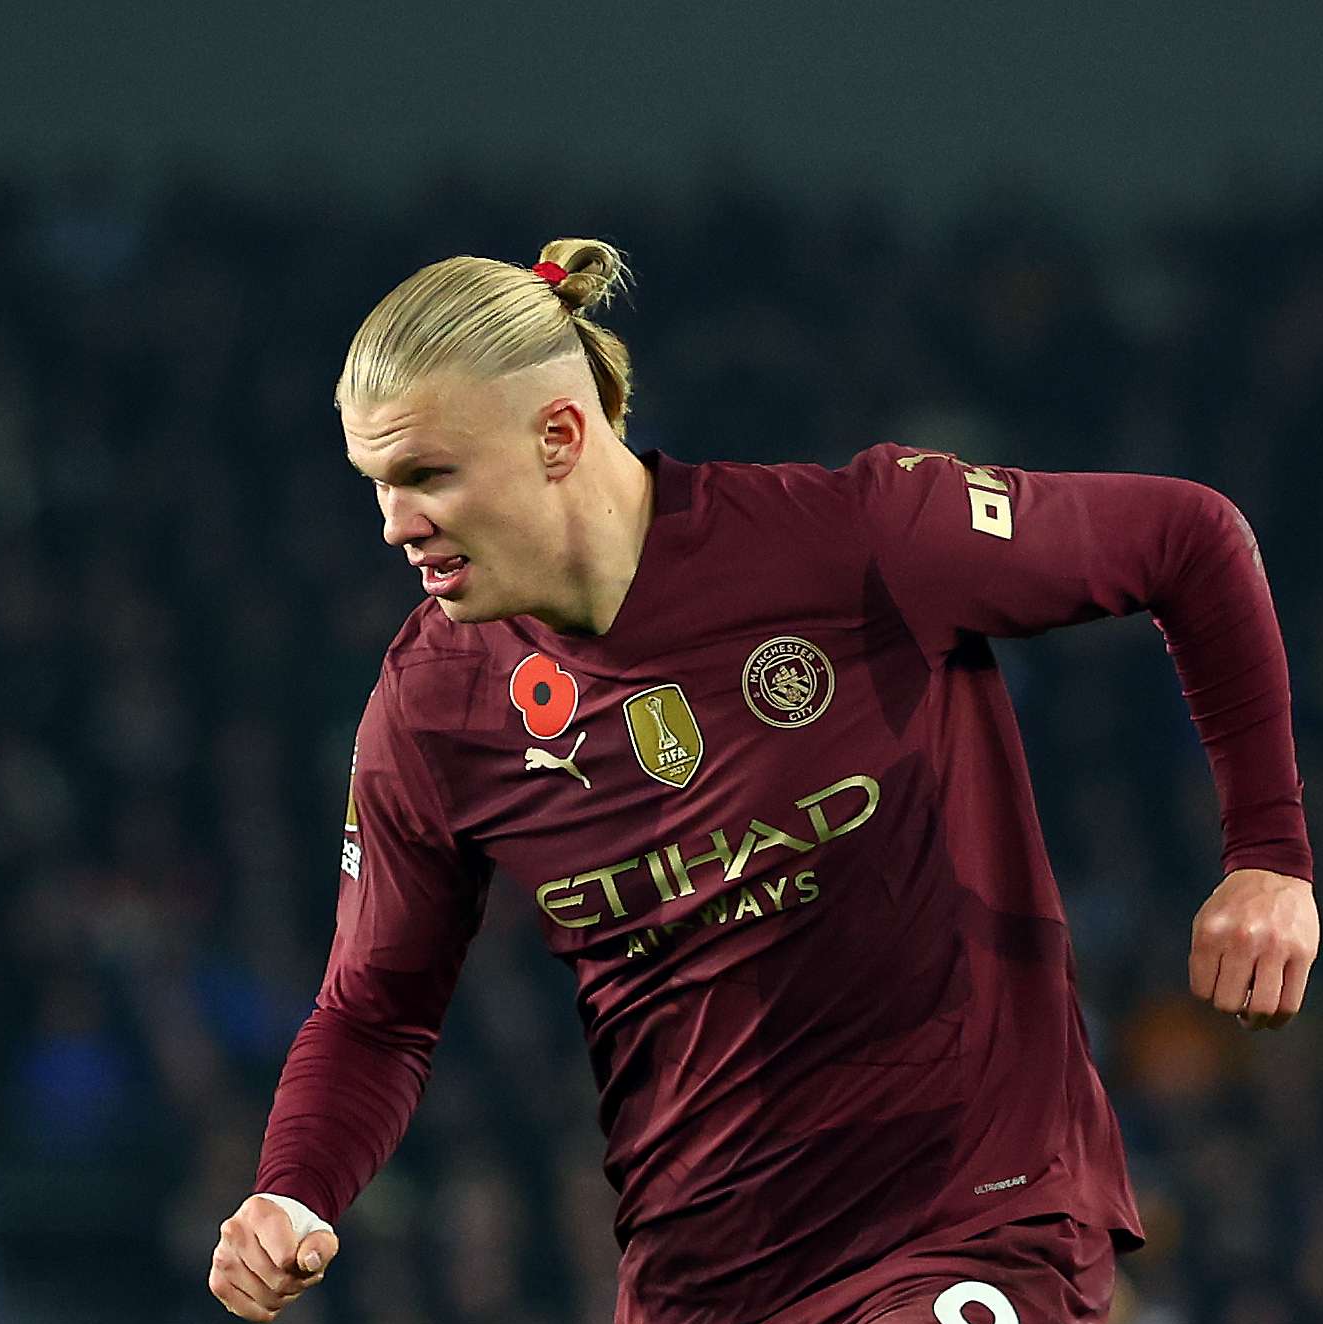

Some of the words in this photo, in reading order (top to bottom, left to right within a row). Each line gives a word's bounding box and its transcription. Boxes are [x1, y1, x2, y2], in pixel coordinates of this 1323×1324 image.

[749, 644, 815, 683] MANCHESTER
[788, 704, 814, 721] CITY
[657, 746, 688, 766] FIFA
[536, 775, 880, 929] ETIHAD
